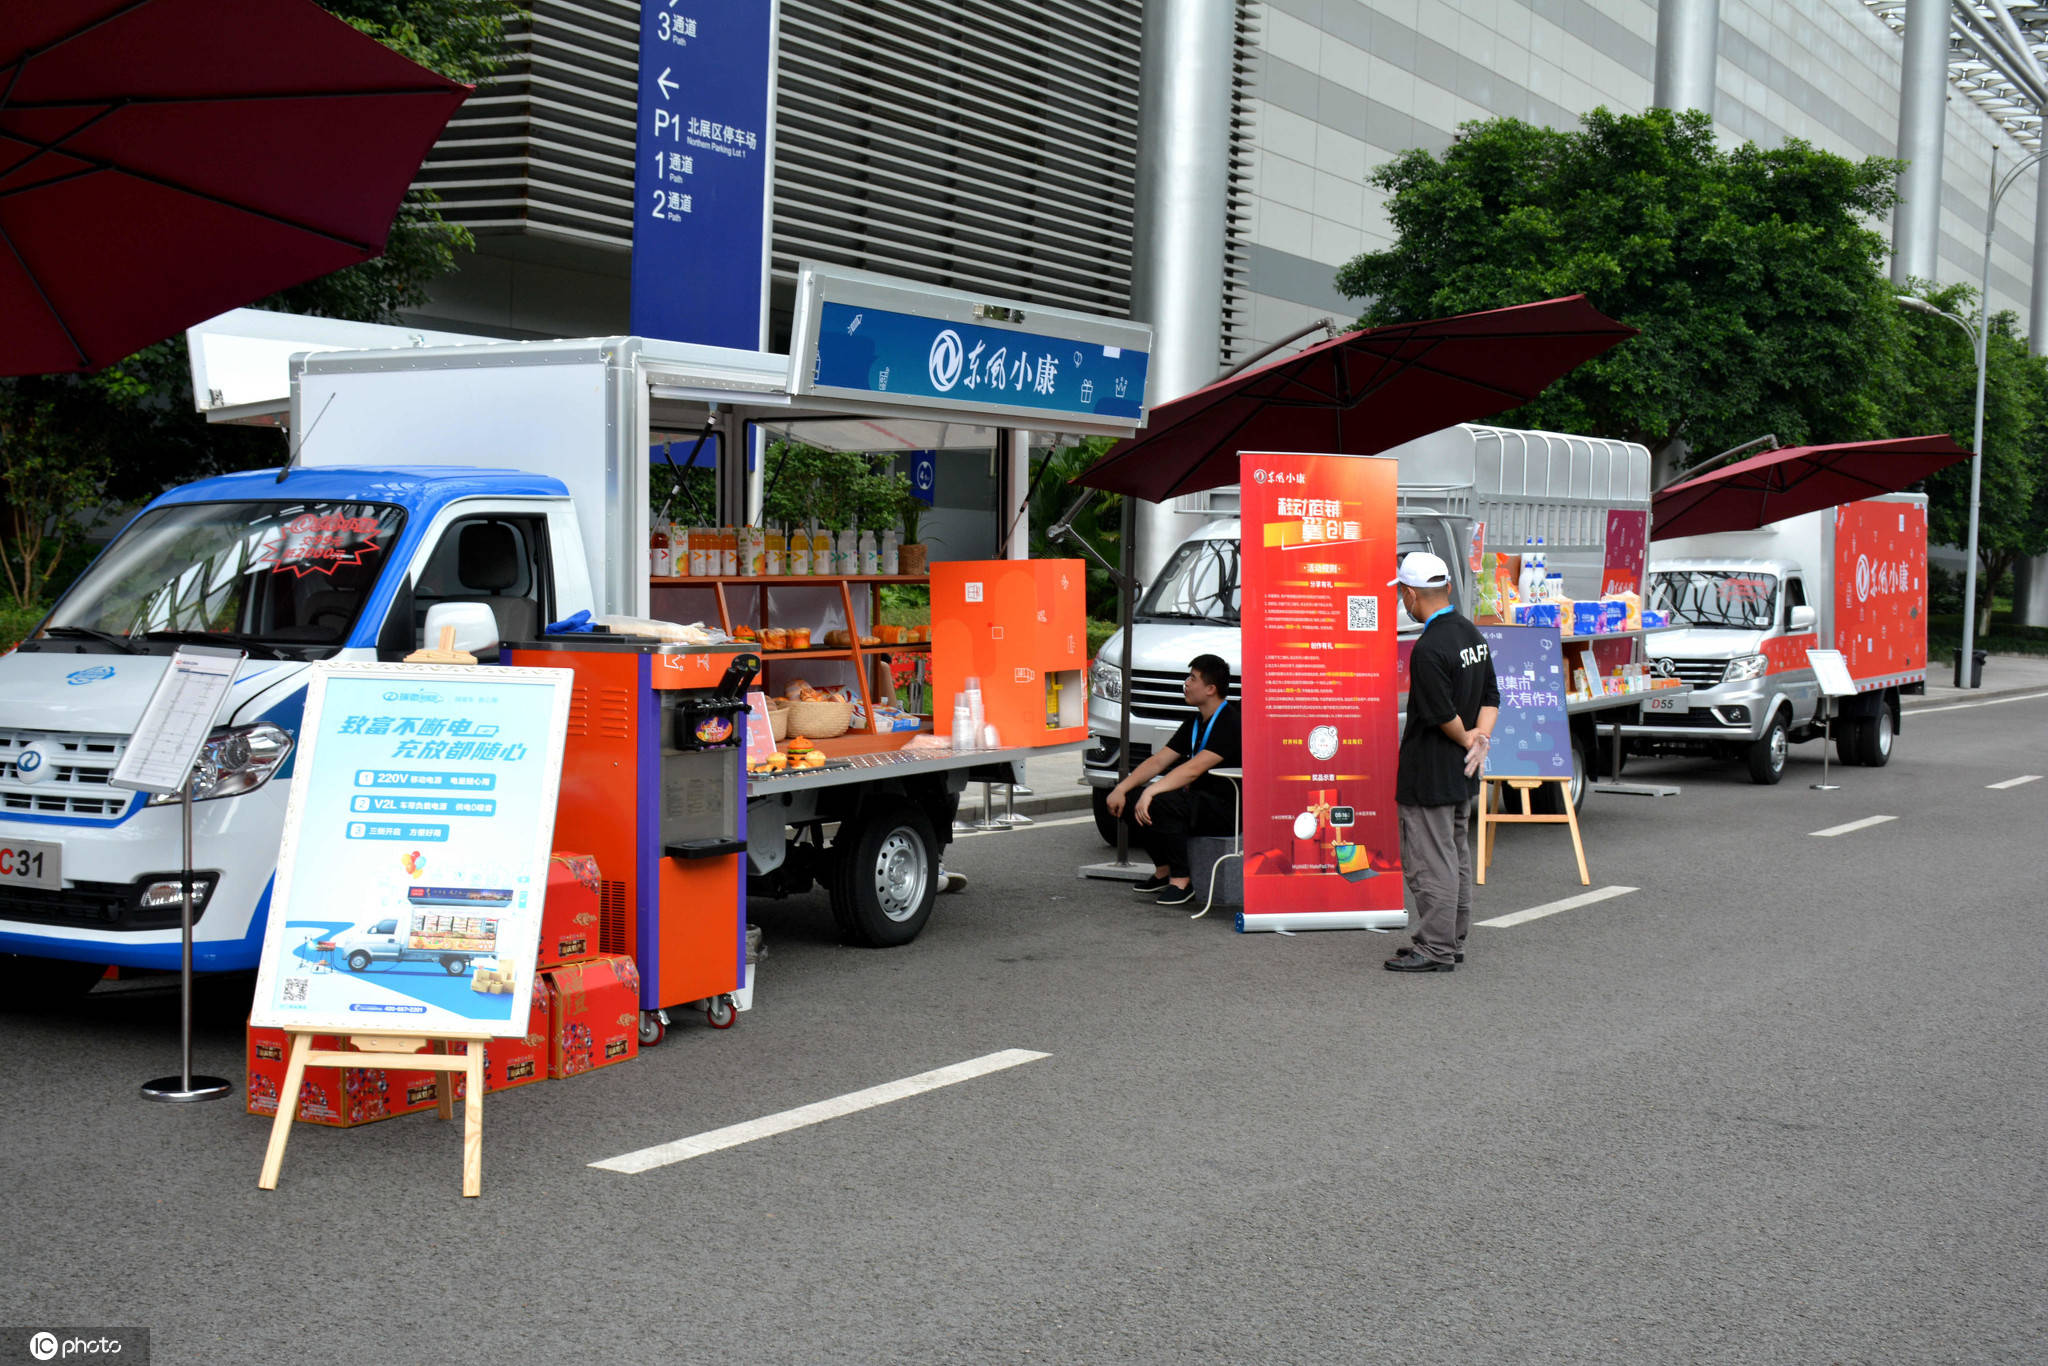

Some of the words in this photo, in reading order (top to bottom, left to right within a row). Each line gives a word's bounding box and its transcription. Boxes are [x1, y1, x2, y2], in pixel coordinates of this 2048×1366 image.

[658, 11, 671, 41] 3
[672, 13, 697, 38] 通道
[673, 34, 687, 47] Path
[654, 108, 680, 142] P1
[687, 116, 757, 150] 北展区停车场
[686, 136, 711, 150] Northern
[711, 142, 733, 157] Parking
[732, 148, 742, 158] Lot
[655, 151, 663, 179] 1
[669, 152, 694, 175] 通道
[669, 172, 684, 184] Path
[652, 189, 666, 219] 2
[668, 190, 693, 213] 通道
[668, 211, 682, 223] Path
[1507, 691, 1558, 707] 大有作为
[1652, 698, 1674, 709] D55
[391, 739, 528, 762] 充放都随心
[377, 773, 409, 784] 220V
[374, 798, 398, 810] V2L
